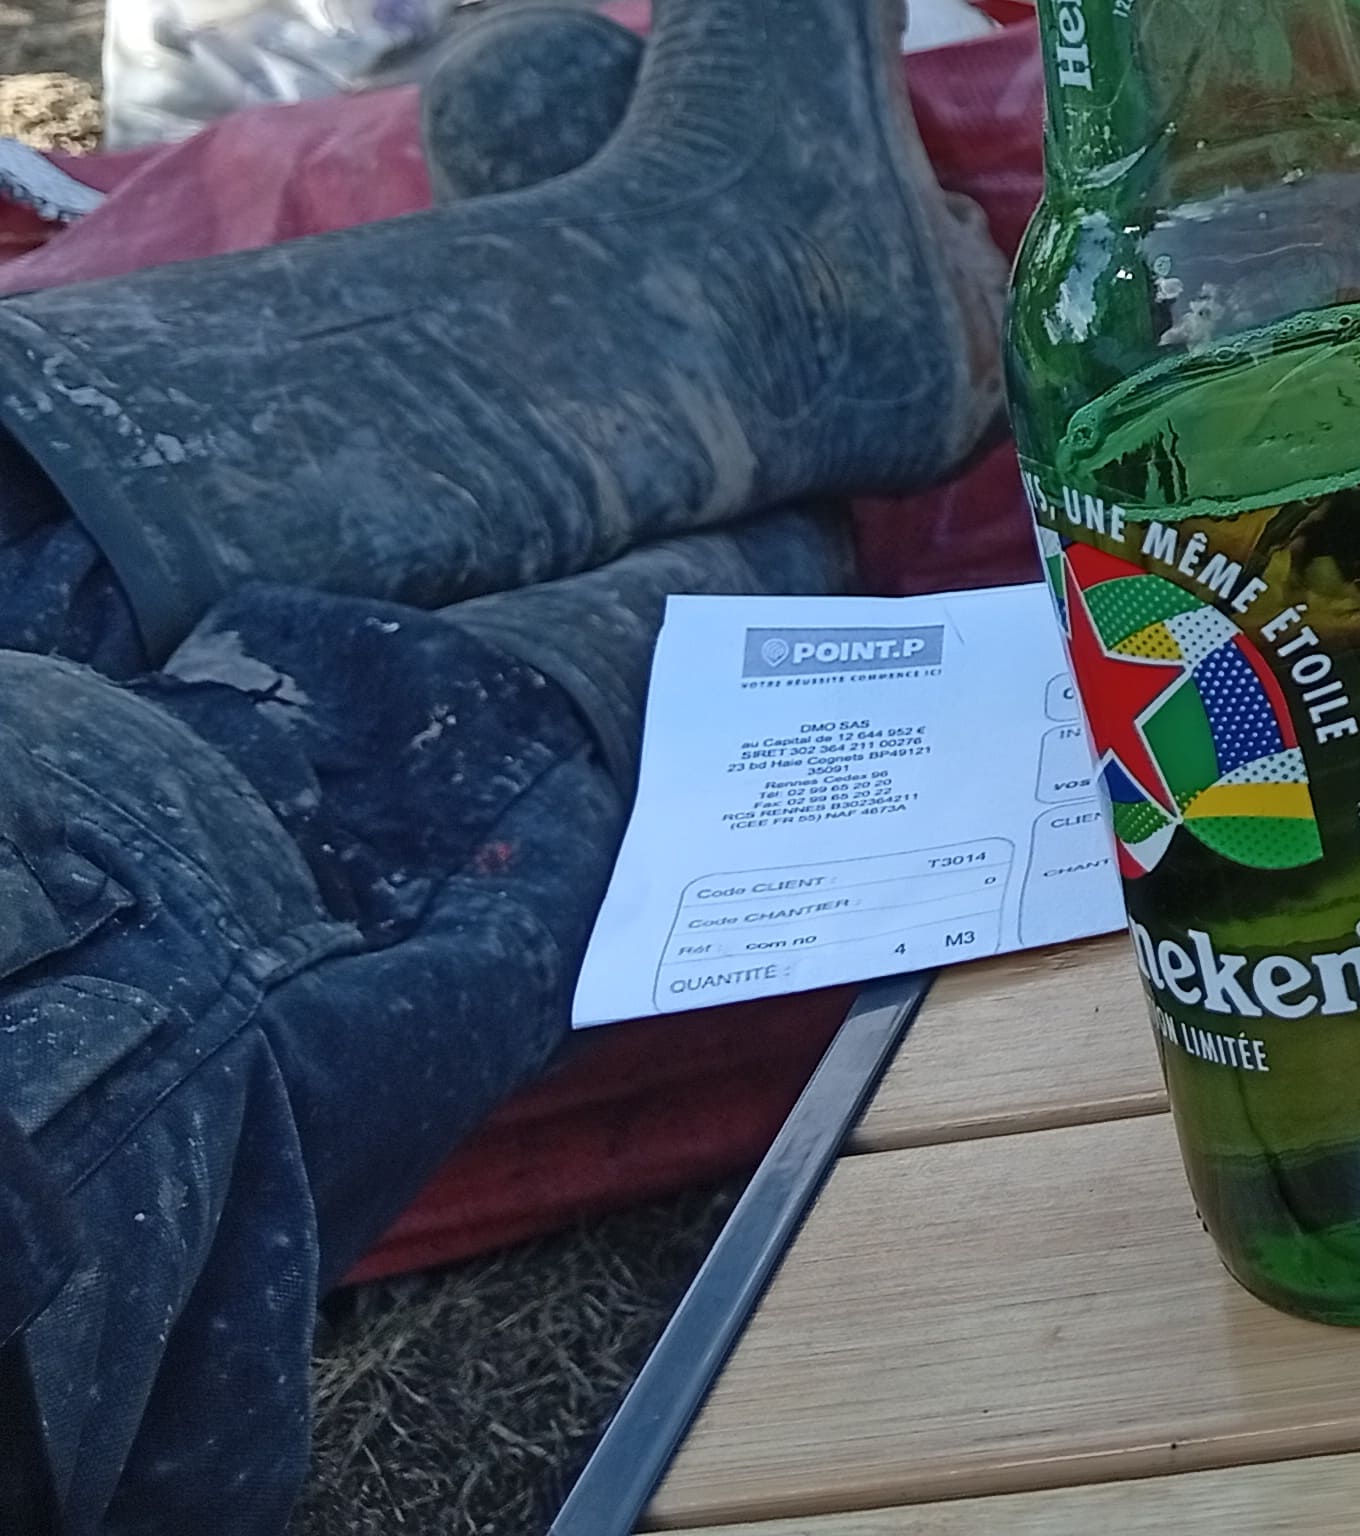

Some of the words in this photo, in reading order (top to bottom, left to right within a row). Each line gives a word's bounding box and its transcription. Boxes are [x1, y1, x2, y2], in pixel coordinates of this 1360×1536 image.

[1062, 485, 1126, 543] UNE
[1141, 520, 1268, 614] MÊME
[1260, 604, 1360, 745] ÉTOILE
[793, 638, 925, 664] POINT.P
[839, 720, 871, 731] SAS
[763, 735, 811, 749] Capital
[839, 731, 854, 742] 12
[741, 747, 788, 761] SIRET
[696, 886, 746, 900] Code
[752, 876, 827, 894] CLIENT
[743, 898, 851, 923] CHANTIER
[894, 942, 907, 956] 4
[944, 930, 976, 948] M3
[1181, 1022, 1270, 1072] LIMITÉE
